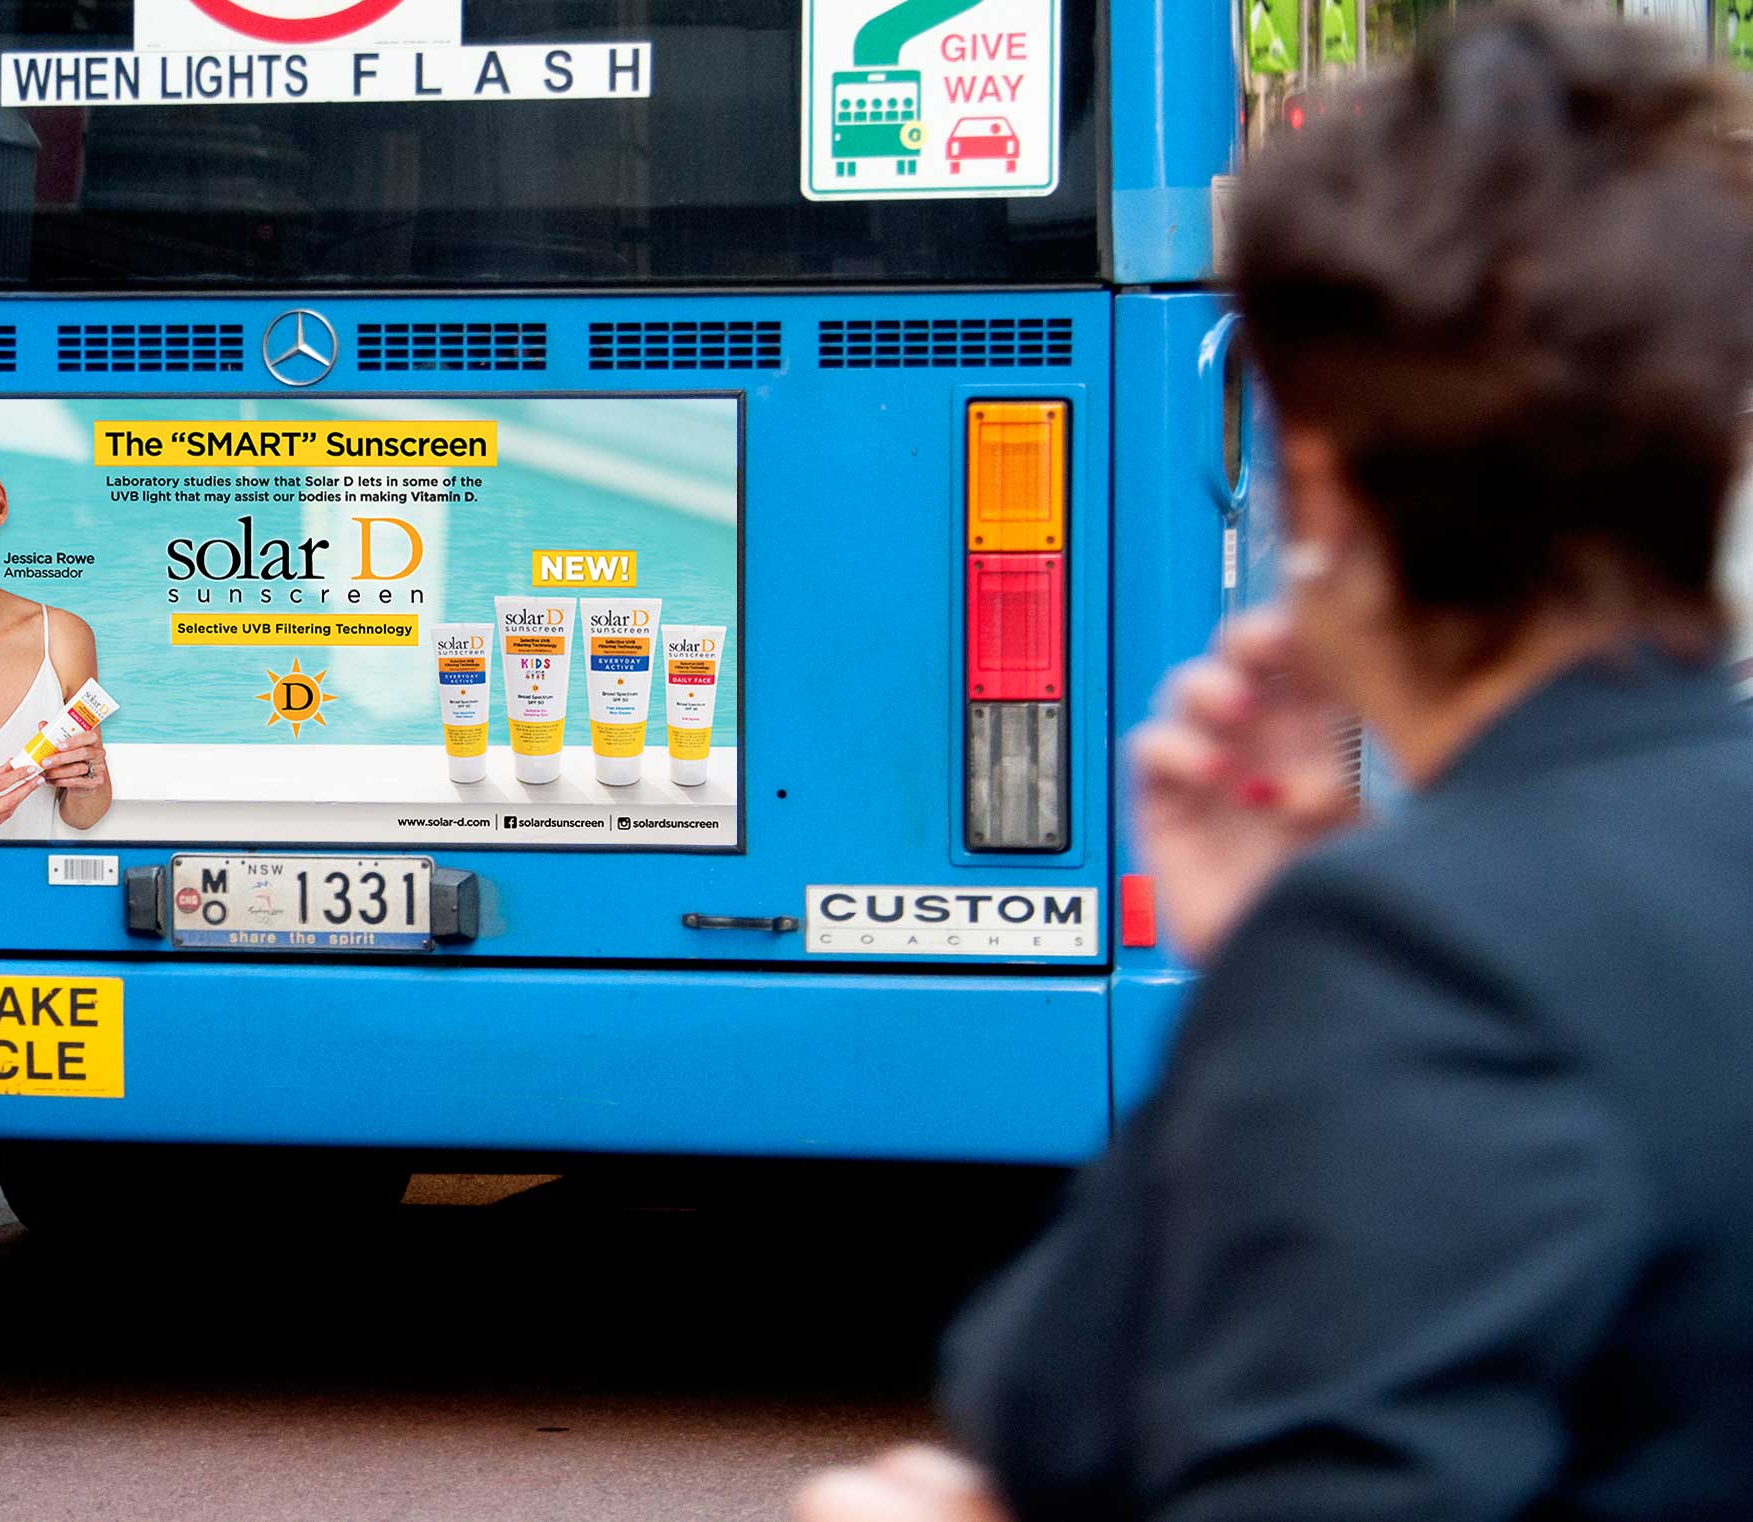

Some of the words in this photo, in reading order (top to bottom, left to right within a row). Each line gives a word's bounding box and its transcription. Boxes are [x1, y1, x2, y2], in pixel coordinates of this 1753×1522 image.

[940, 32, 1028, 62] GIVE
[13, 56, 139, 101] WHEN
[160, 54, 308, 99] LIGHTS
[943, 74, 1024, 104] WAY
[105, 432, 163, 457] The
[326, 432, 487, 457] Sunscreen
[106, 476, 180, 490] Laboratory
[184, 476, 230, 487] studies
[235, 476, 271, 487] show
[274, 476, 301, 487] that
[305, 476, 340, 487] Solar
[344, 477, 354, 487] D
[358, 476, 382, 487] lets
[386, 476, 398, 487] in
[402, 479, 438, 487] some
[442, 476, 456, 487] of
[460, 476, 482, 487] the
[111, 492, 138, 502] UVB
[142, 491, 172, 505] light
[174, 491, 201, 502] that
[204, 493, 231, 505] may
[234, 491, 269, 502] assist
[273, 494, 295, 502] our
[298, 491, 341, 502] bodies
[345, 491, 356, 502] in
[360, 491, 407, 505] making
[411, 491, 461, 502] Vitamin
[465, 492, 478, 502] D.
[166, 515, 330, 581] solar
[351, 517, 424, 580] D
[3, 552, 54, 565] Jessica
[57, 553, 95, 565] Rowe
[3, 567, 84, 579] Ambassador
[540, 555, 630, 581] NEW!
[168, 588, 424, 604] sunscreen
[505, 608, 545, 625] solar
[547, 608, 564, 625] D
[590, 610, 630, 627] solar
[632, 609, 650, 627] D
[177, 623, 238, 635] Selective
[242, 624, 271, 635] UVB
[275, 623, 331, 638] Filtering
[336, 623, 413, 638] Technology
[437, 636, 470, 650] solar
[470, 636, 485, 650] D
[668, 639, 700, 652] solar
[702, 639, 716, 653] D
[521, 658, 551, 669] KIDS
[281, 682, 313, 711] D
[397, 817, 491, 828] www.solar-d.com
[519, 817, 605, 828] solardsunscreen
[633, 818, 719, 829] solardsunscreen
[248, 864, 284, 875] NSW
[298, 871, 415, 925] 1331
[820, 893, 1083, 924] CUSTOM
[229, 930, 276, 944] share
[289, 931, 316, 945] the
[329, 931, 376, 948] spirit
